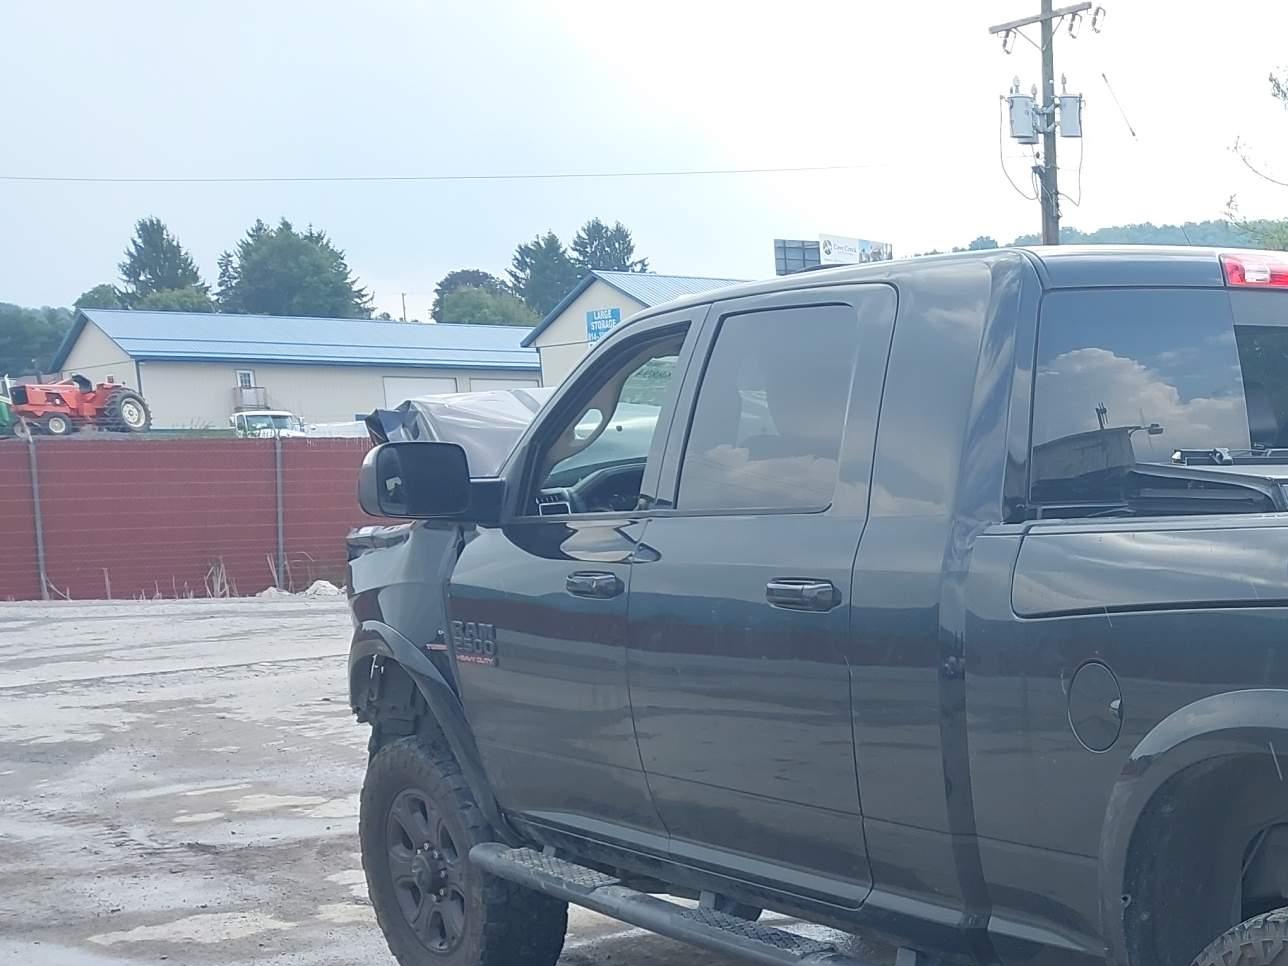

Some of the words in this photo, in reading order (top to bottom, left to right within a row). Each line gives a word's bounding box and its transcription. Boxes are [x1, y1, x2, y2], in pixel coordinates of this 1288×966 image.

[593, 309, 612, 320] LARGE
[591, 319, 617, 331] STORAGE
[451, 620, 494, 641] RAM
